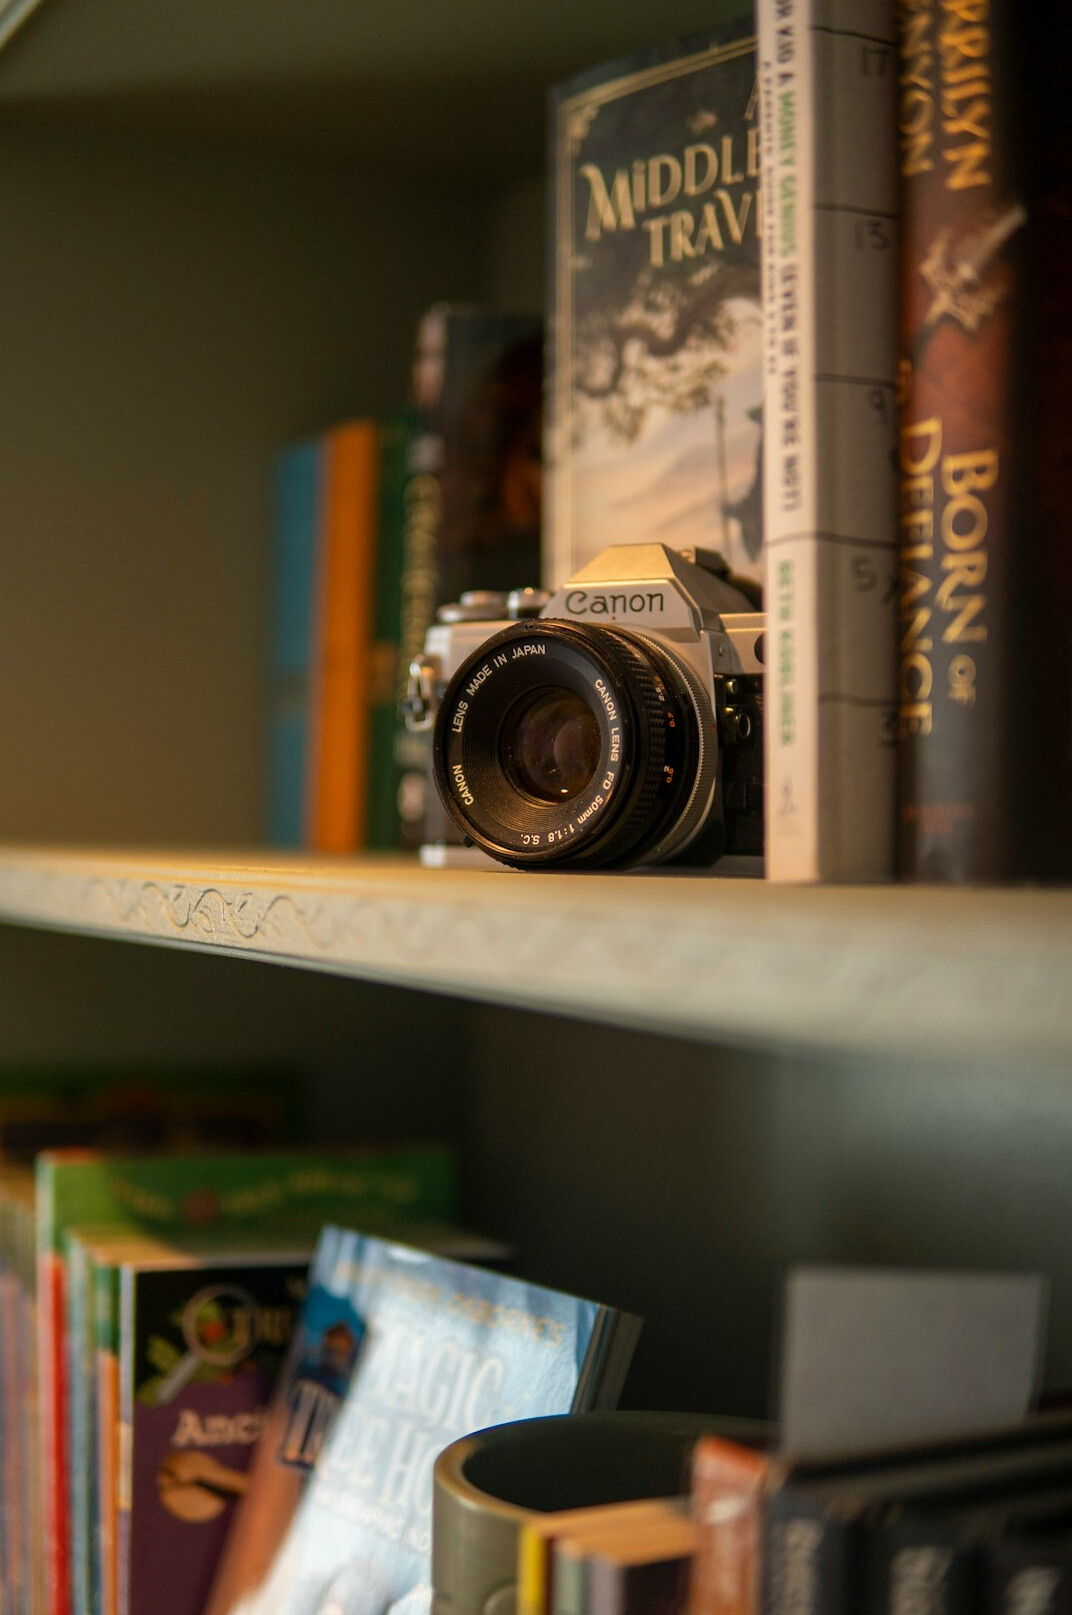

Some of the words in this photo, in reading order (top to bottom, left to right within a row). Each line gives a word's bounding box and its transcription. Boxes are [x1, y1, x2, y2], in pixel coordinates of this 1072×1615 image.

[777, 71, 794, 86] A
[779, 91, 795, 166] MONEY
[641, 187, 762, 268] TRAV
[935, 447, 999, 645] BORN
[777, 560, 795, 622] BETH
[899, 415, 944, 737] DEFIANCE
[565, 590, 665, 615] Canon
[492, 653, 508, 668] IN
[511, 644, 546, 659] JAPAN
[465, 664, 493, 697] MADE
[595, 678, 618, 721] CANON
[452, 700, 468, 733] LENS
[610, 727, 620, 762] LENS
[452, 764, 474, 806] CANON
[602, 771, 615, 790] FD
[577, 794, 604, 825] 50mm
[548, 823, 575, 843] 1:1.8
